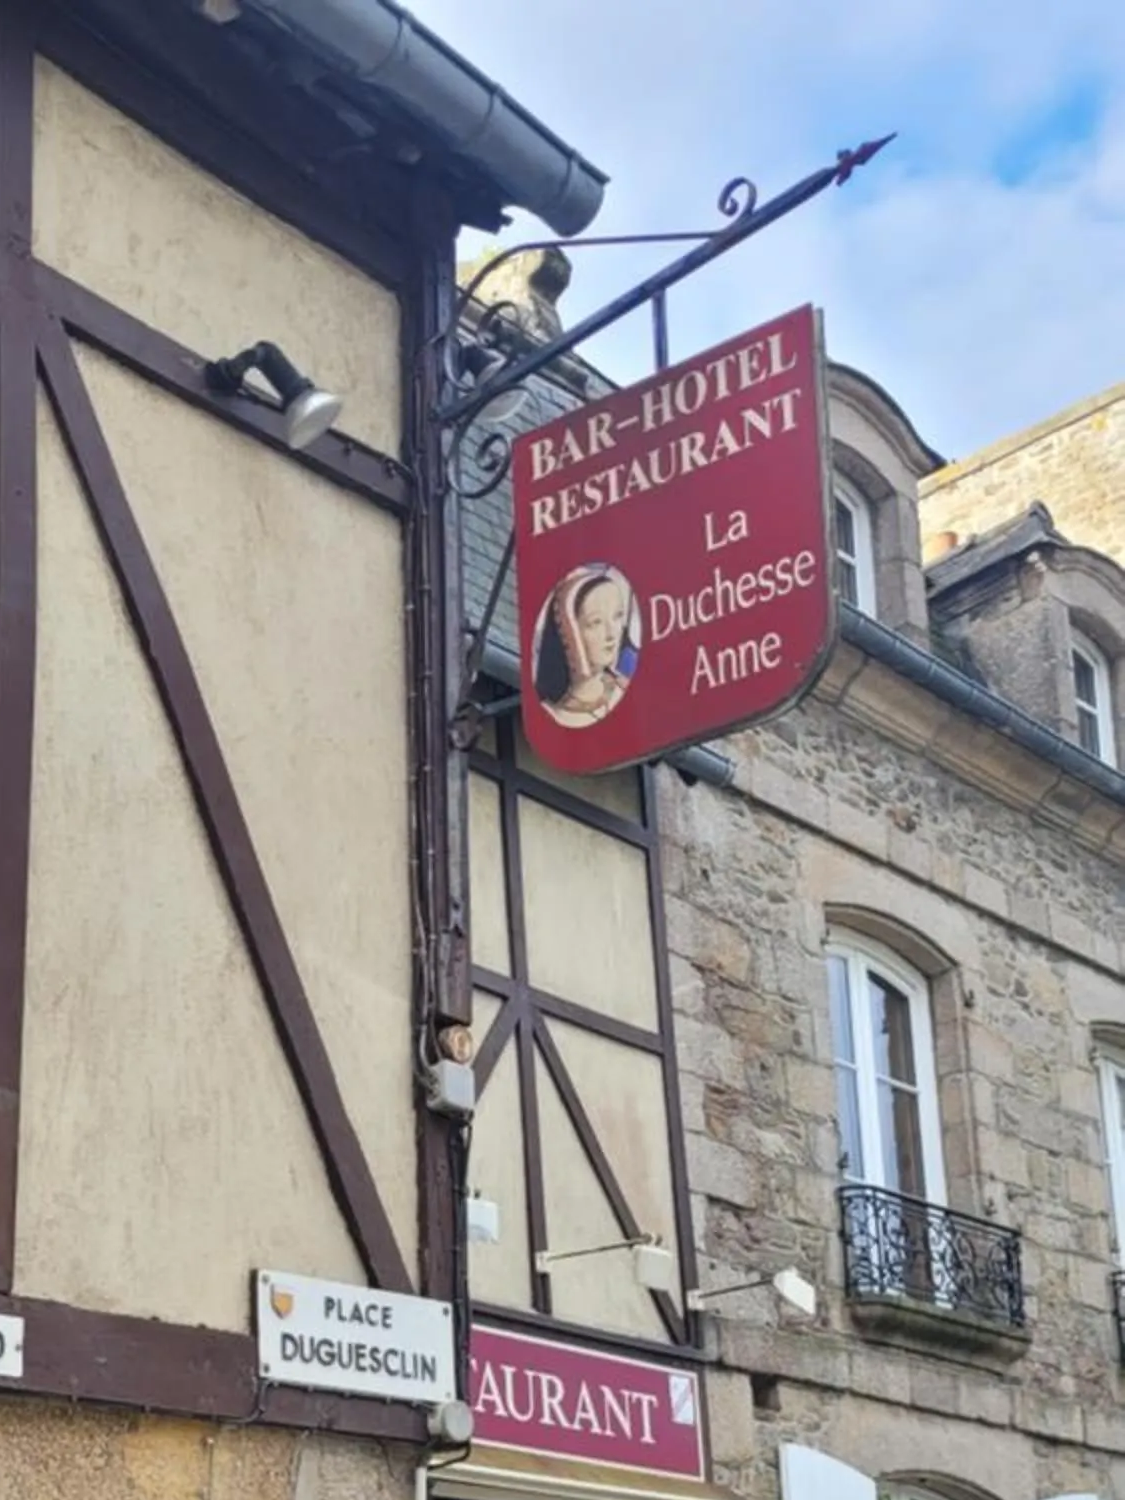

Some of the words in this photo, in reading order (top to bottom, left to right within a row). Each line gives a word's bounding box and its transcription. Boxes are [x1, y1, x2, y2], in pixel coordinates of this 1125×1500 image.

[529, 332, 797, 481] BAR-HOTEL
[530, 387, 801, 537] RESTAURANT
[703, 509, 748, 552] La
[649, 549, 816, 642] Duchesse
[690, 630, 782, 695] Anne
[324, 1296, 393, 1329] PLACE
[280, 1332, 437, 1383] DUGUESCLIN
[470, 1358, 658, 1444] AURANT
